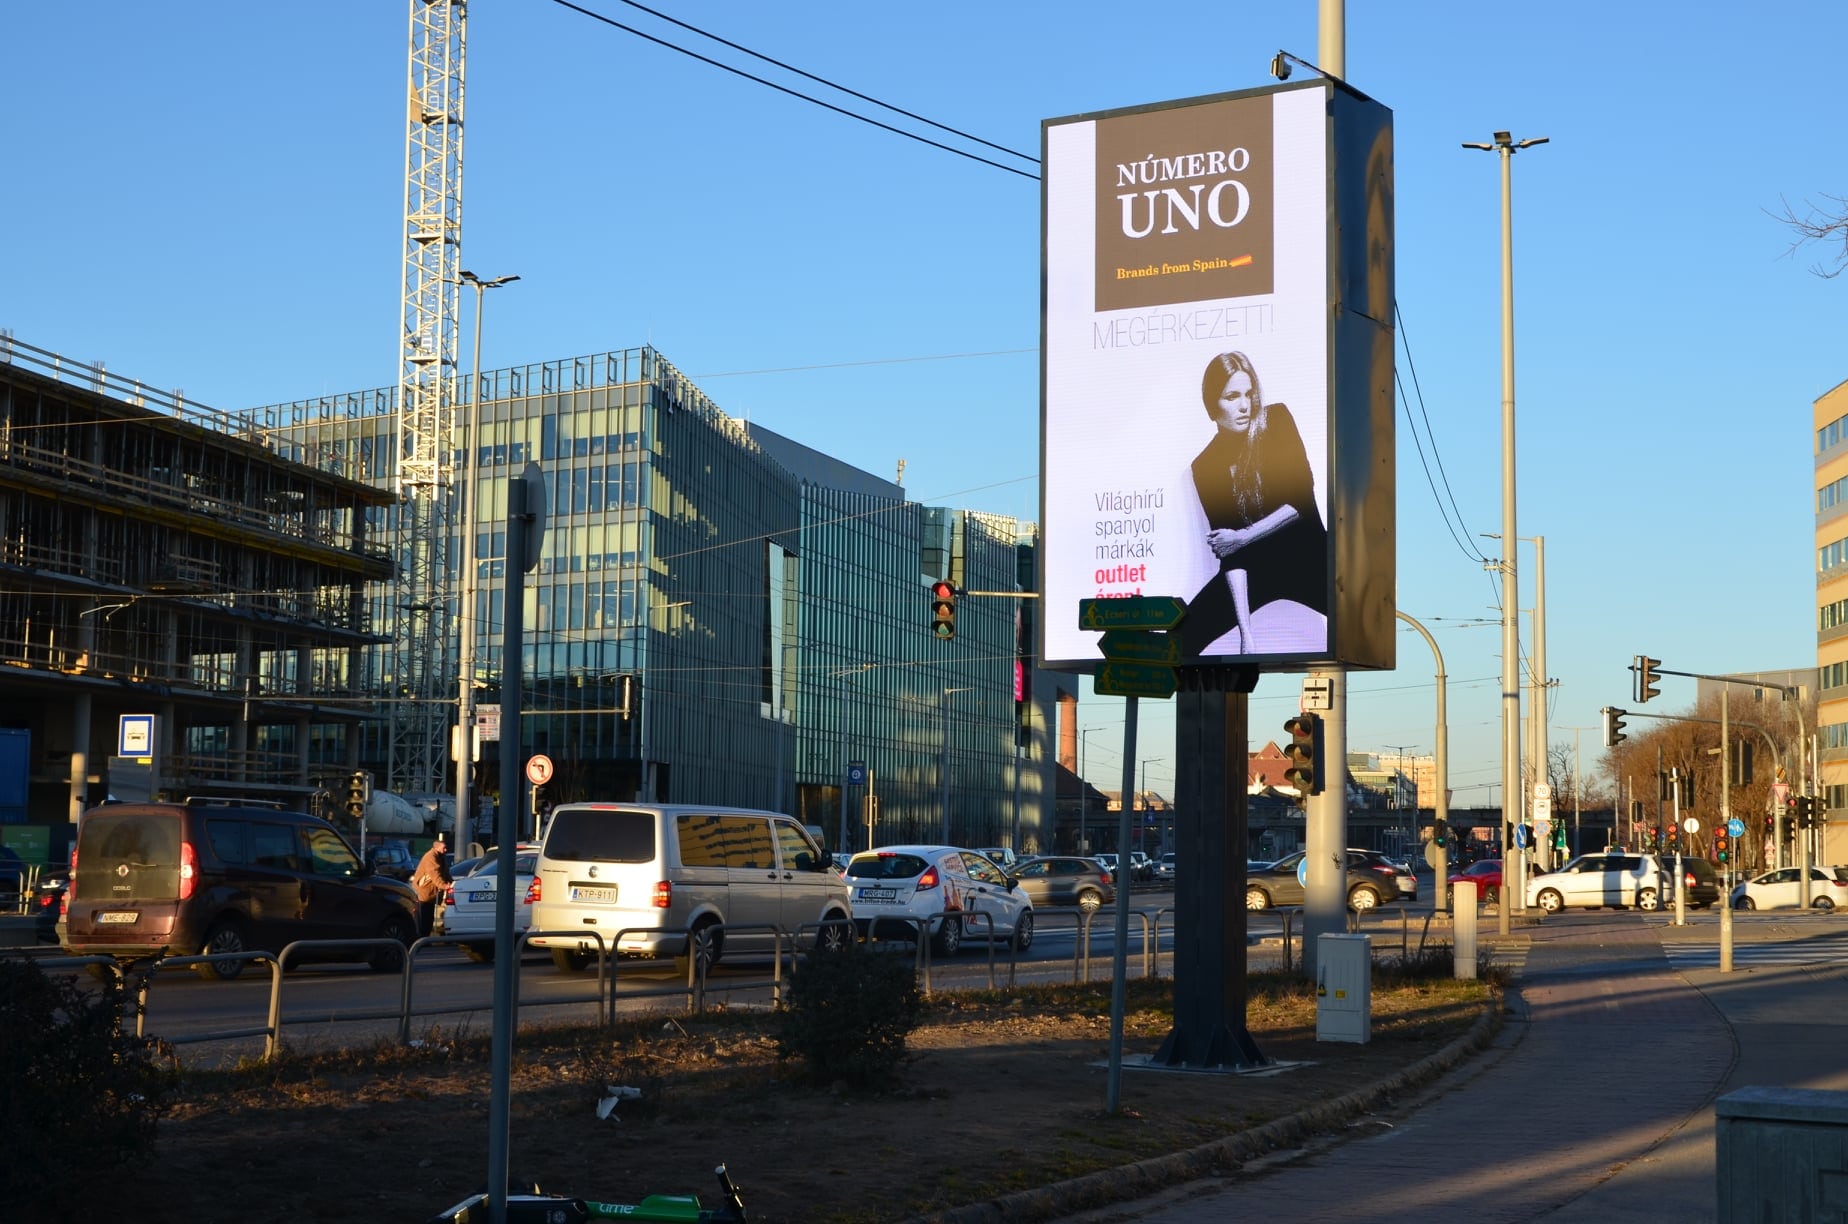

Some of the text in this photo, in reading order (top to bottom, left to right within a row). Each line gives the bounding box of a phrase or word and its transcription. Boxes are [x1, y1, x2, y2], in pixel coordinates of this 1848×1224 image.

[1116, 148, 1250, 187] NÚMERO
[1116, 180, 1251, 239] UNO
[1116, 256, 1229, 280] Brands from Spain
[1093, 303, 1277, 351] MEGÉRKEZETT!
[1095, 488, 1164, 514] Világhírű
[1095, 514, 1155, 540] spanyol
[1095, 539, 1155, 560] márkák
[1095, 563, 1146, 585] outlet
[577, 890, 612, 900] KTP-911
[864, 889, 894, 897] MRG-407
